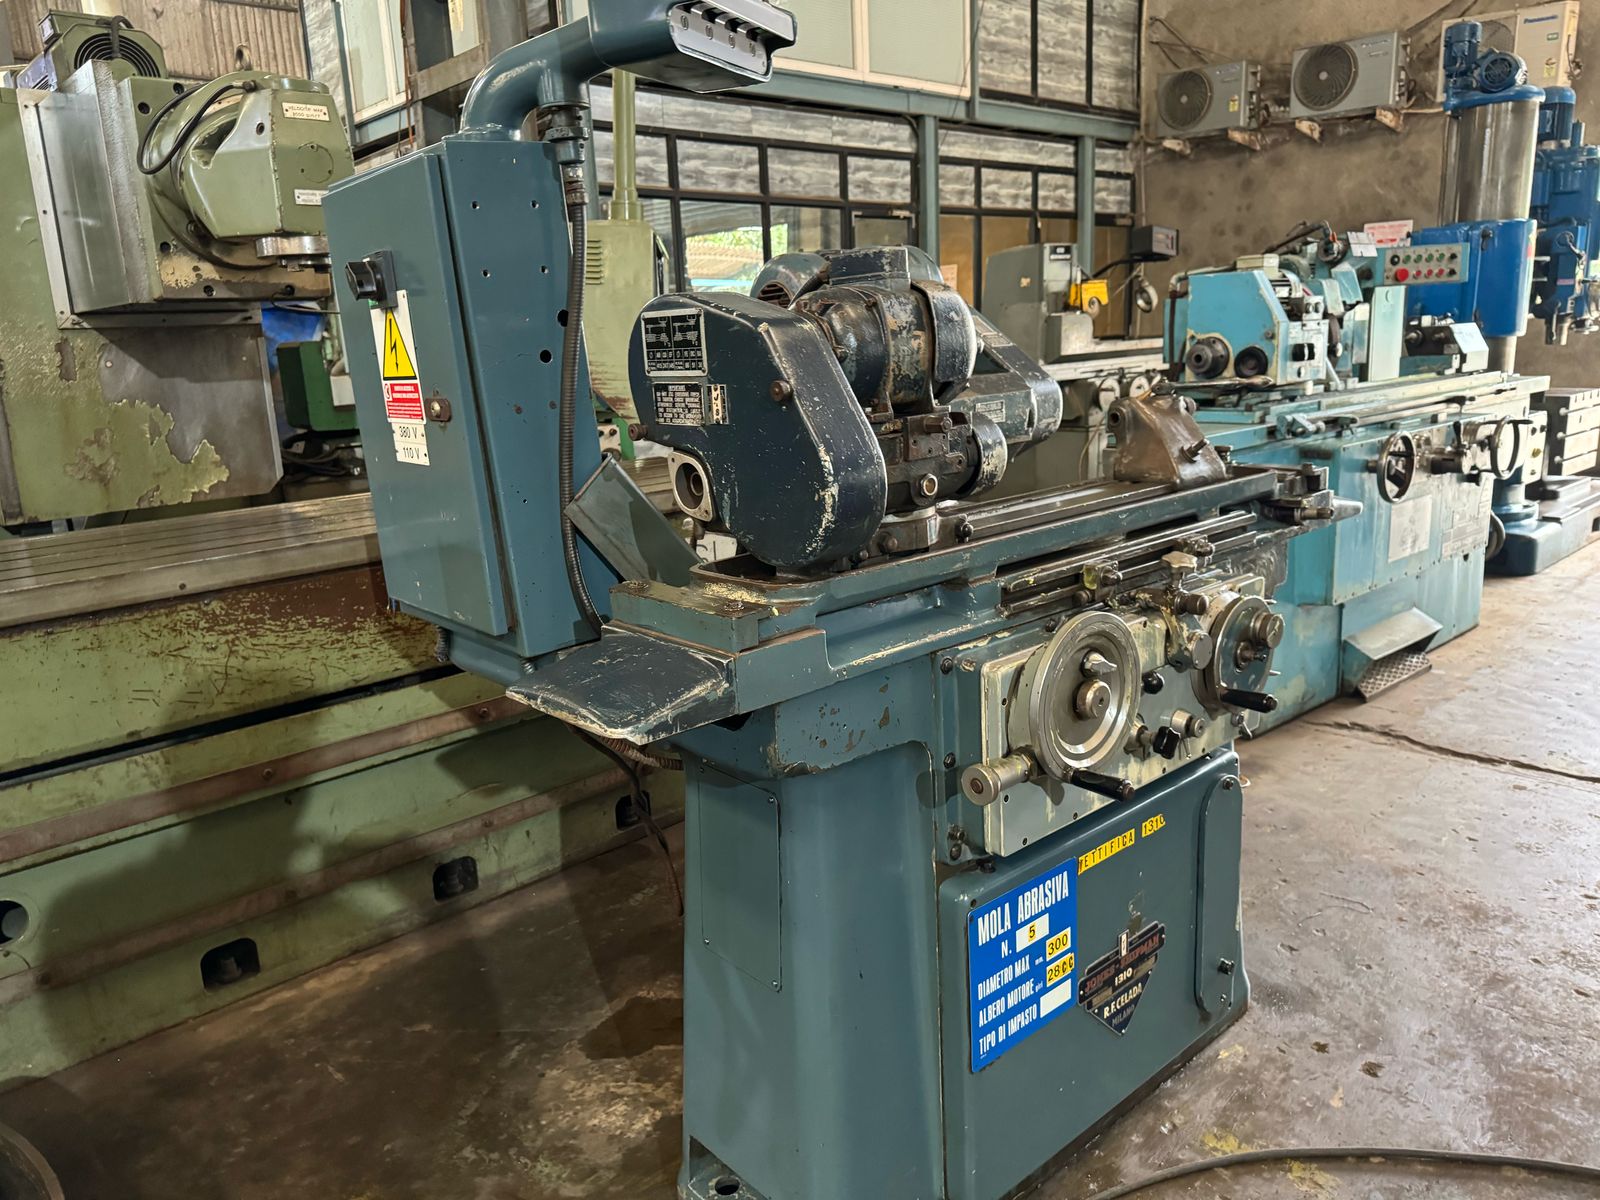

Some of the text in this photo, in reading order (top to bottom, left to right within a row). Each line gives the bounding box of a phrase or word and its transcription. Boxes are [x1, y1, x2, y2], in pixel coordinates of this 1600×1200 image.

[399, 426, 418, 439] 380 V
[403, 447, 420, 460] 110 V
[978, 870, 1069, 946] MOLA ABRASIVA
[1001, 924, 1036, 958] N. 5
[977, 964, 1013, 1001] DIAMETRO
[1014, 954, 1030, 978] MAX
[1047, 933, 1069, 956] 300
[1114, 967, 1133, 987] 1310
[978, 996, 1006, 1028] ALBERO
[1007, 978, 1035, 1009] MOTORE
[1111, 1004, 1135, 1027] MILANO
[979, 1003, 1038, 1055] TIPO DI IMPASTO
